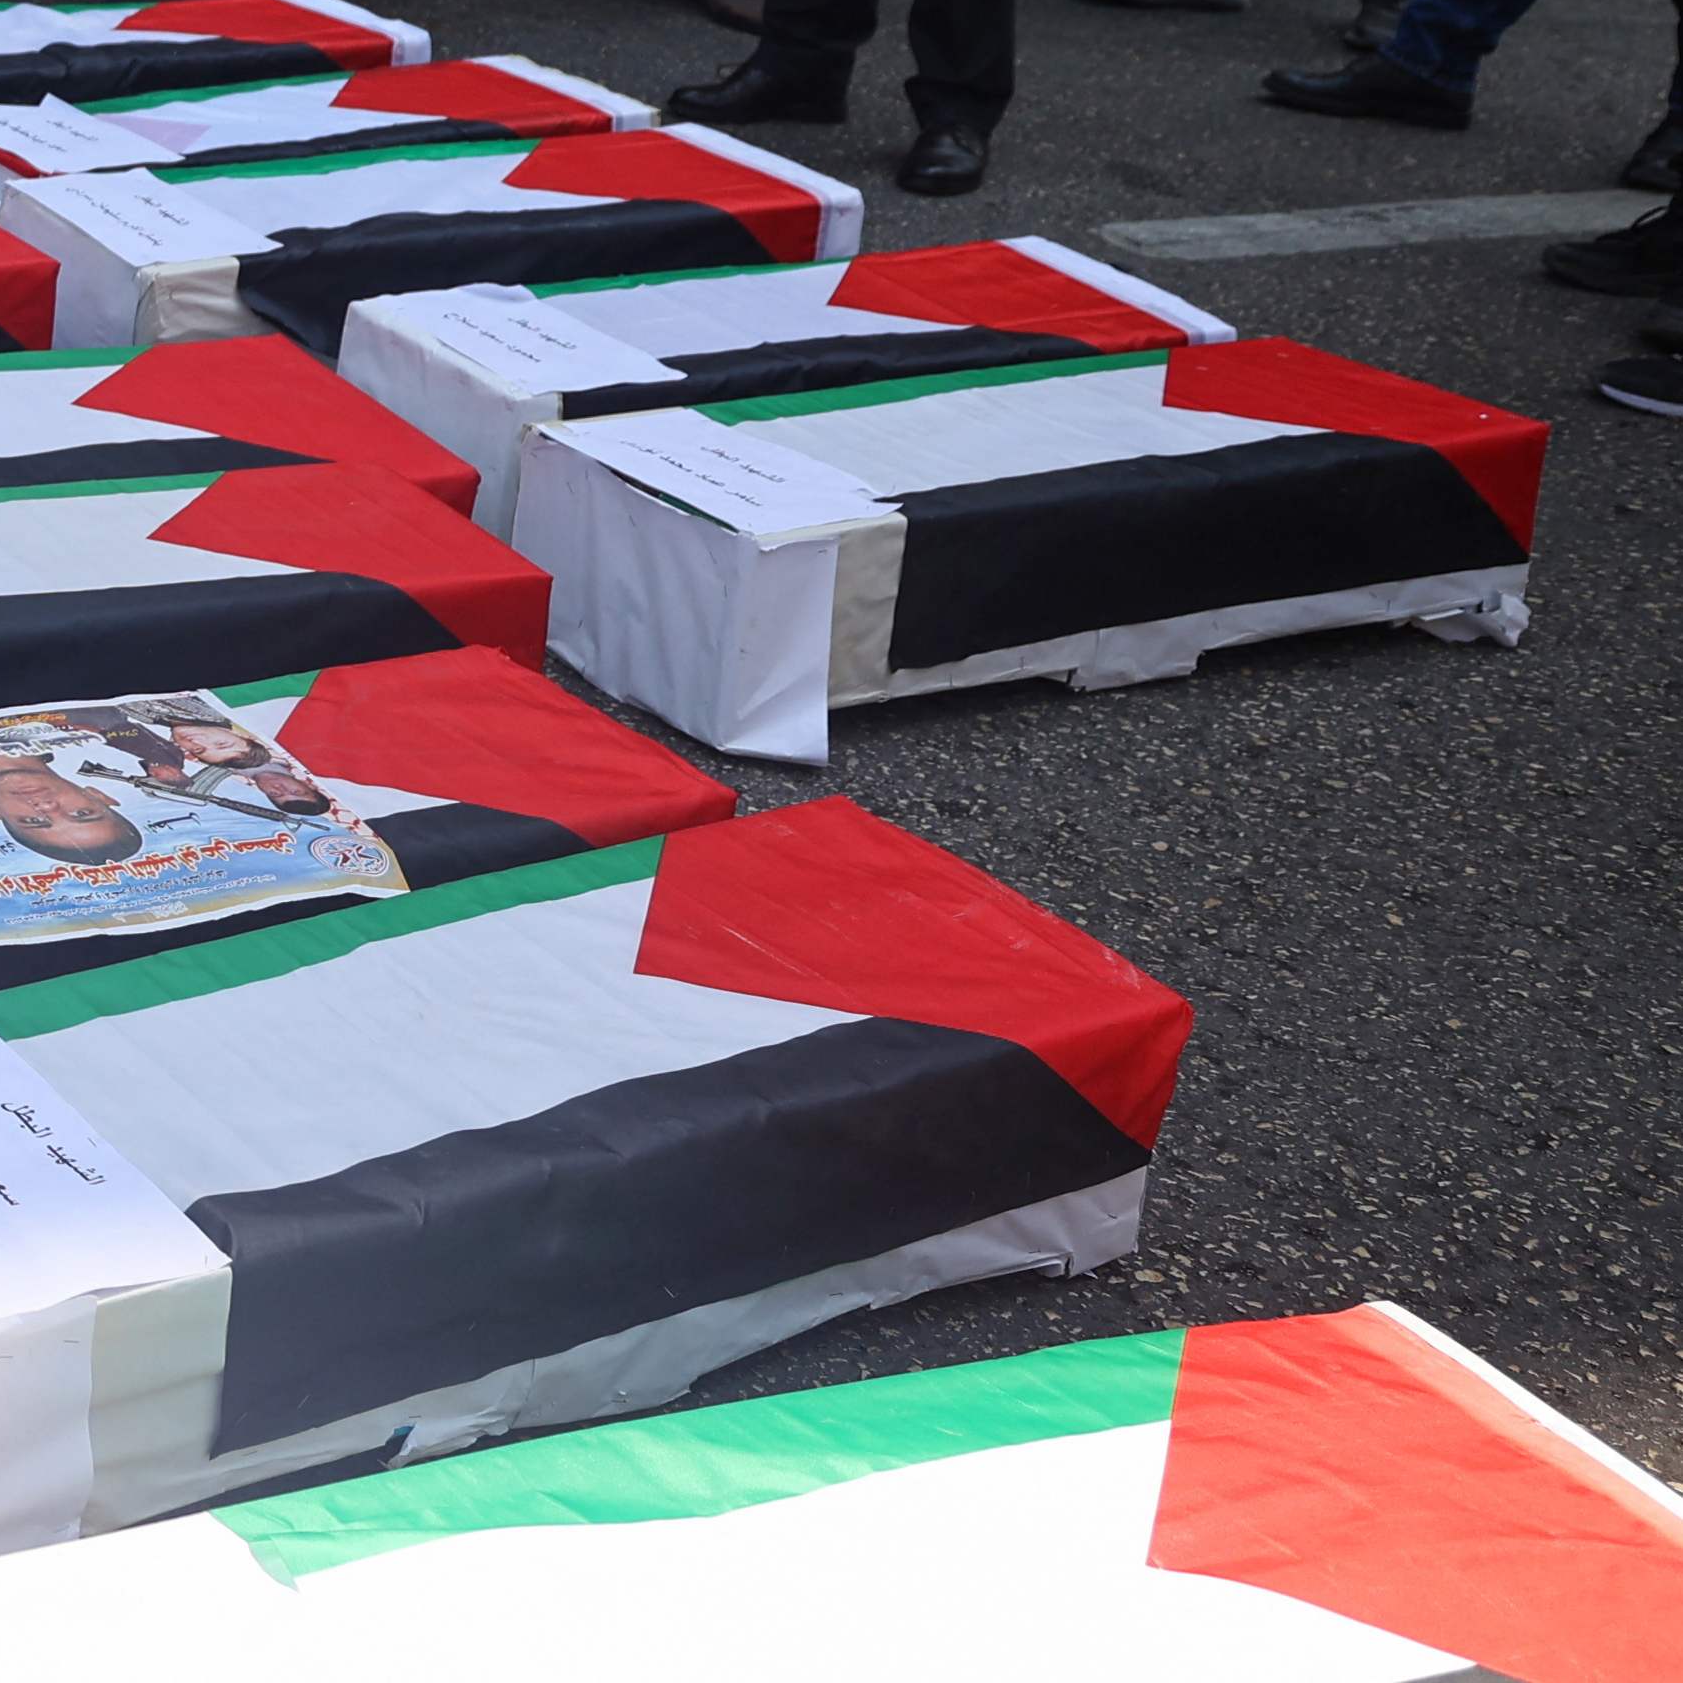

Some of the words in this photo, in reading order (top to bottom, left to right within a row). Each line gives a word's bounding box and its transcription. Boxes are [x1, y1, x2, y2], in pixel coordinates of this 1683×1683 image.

[167, 844, 216, 873] أبو
[187, 834, 244, 864] علي
[222, 830, 308, 861] مصطفى
[4, 864, 87, 898] الأقصى
[63, 857, 141, 890] وكتائب
[116, 851, 191, 882] الشهيد
[1, 1104, 52, 1138] البطل
[47, 1145, 105, 1184] الشهيد
